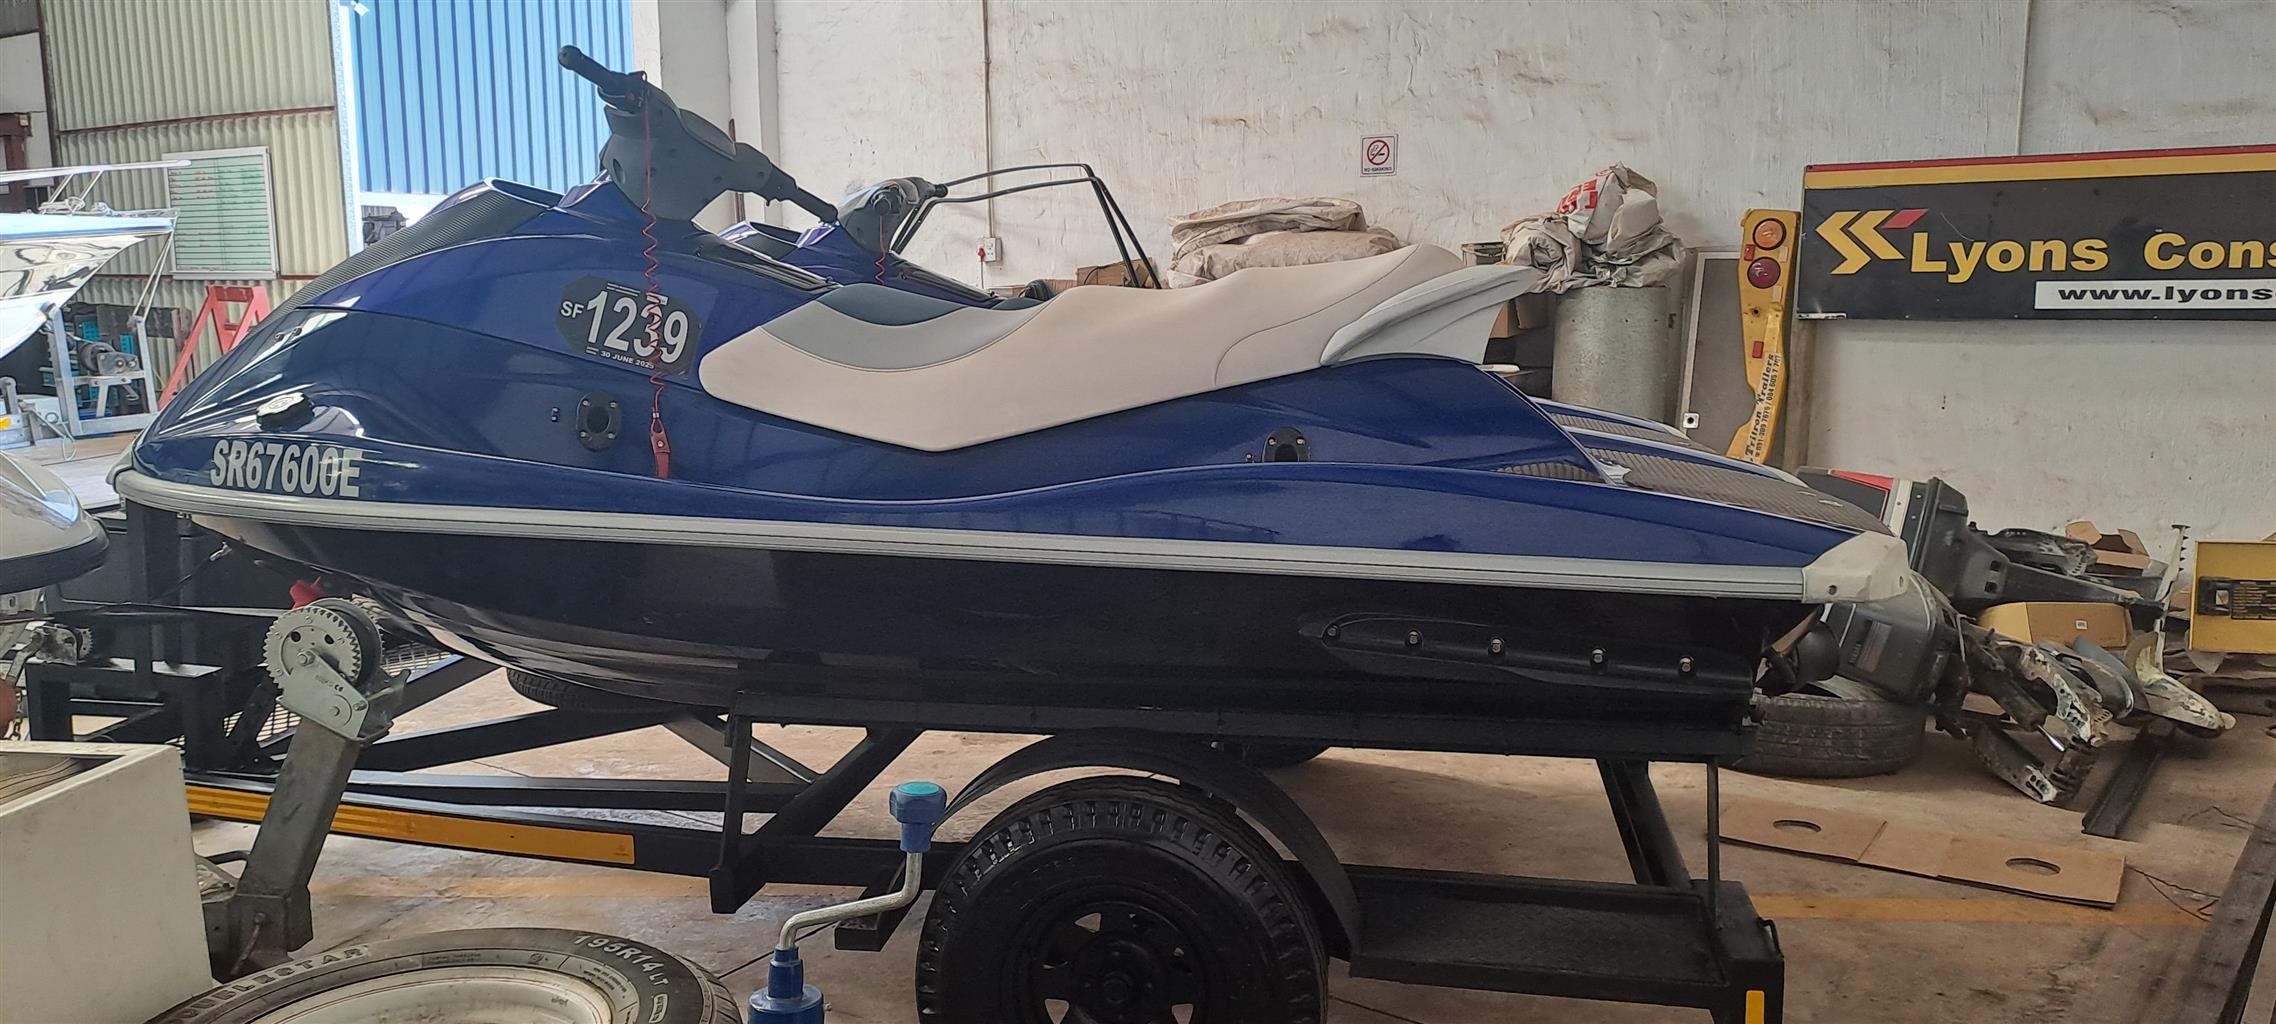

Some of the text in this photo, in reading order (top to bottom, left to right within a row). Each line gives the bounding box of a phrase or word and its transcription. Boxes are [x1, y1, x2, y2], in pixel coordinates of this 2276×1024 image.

[1910, 231, 2276, 284] Lyons Con
[2057, 285, 2276, 304] www.lyons
[560, 290, 689, 363] SF 1239
[600, 350, 611, 358] 30
[612, 352, 634, 364] JUNE
[210, 439, 363, 497] SR67600E
